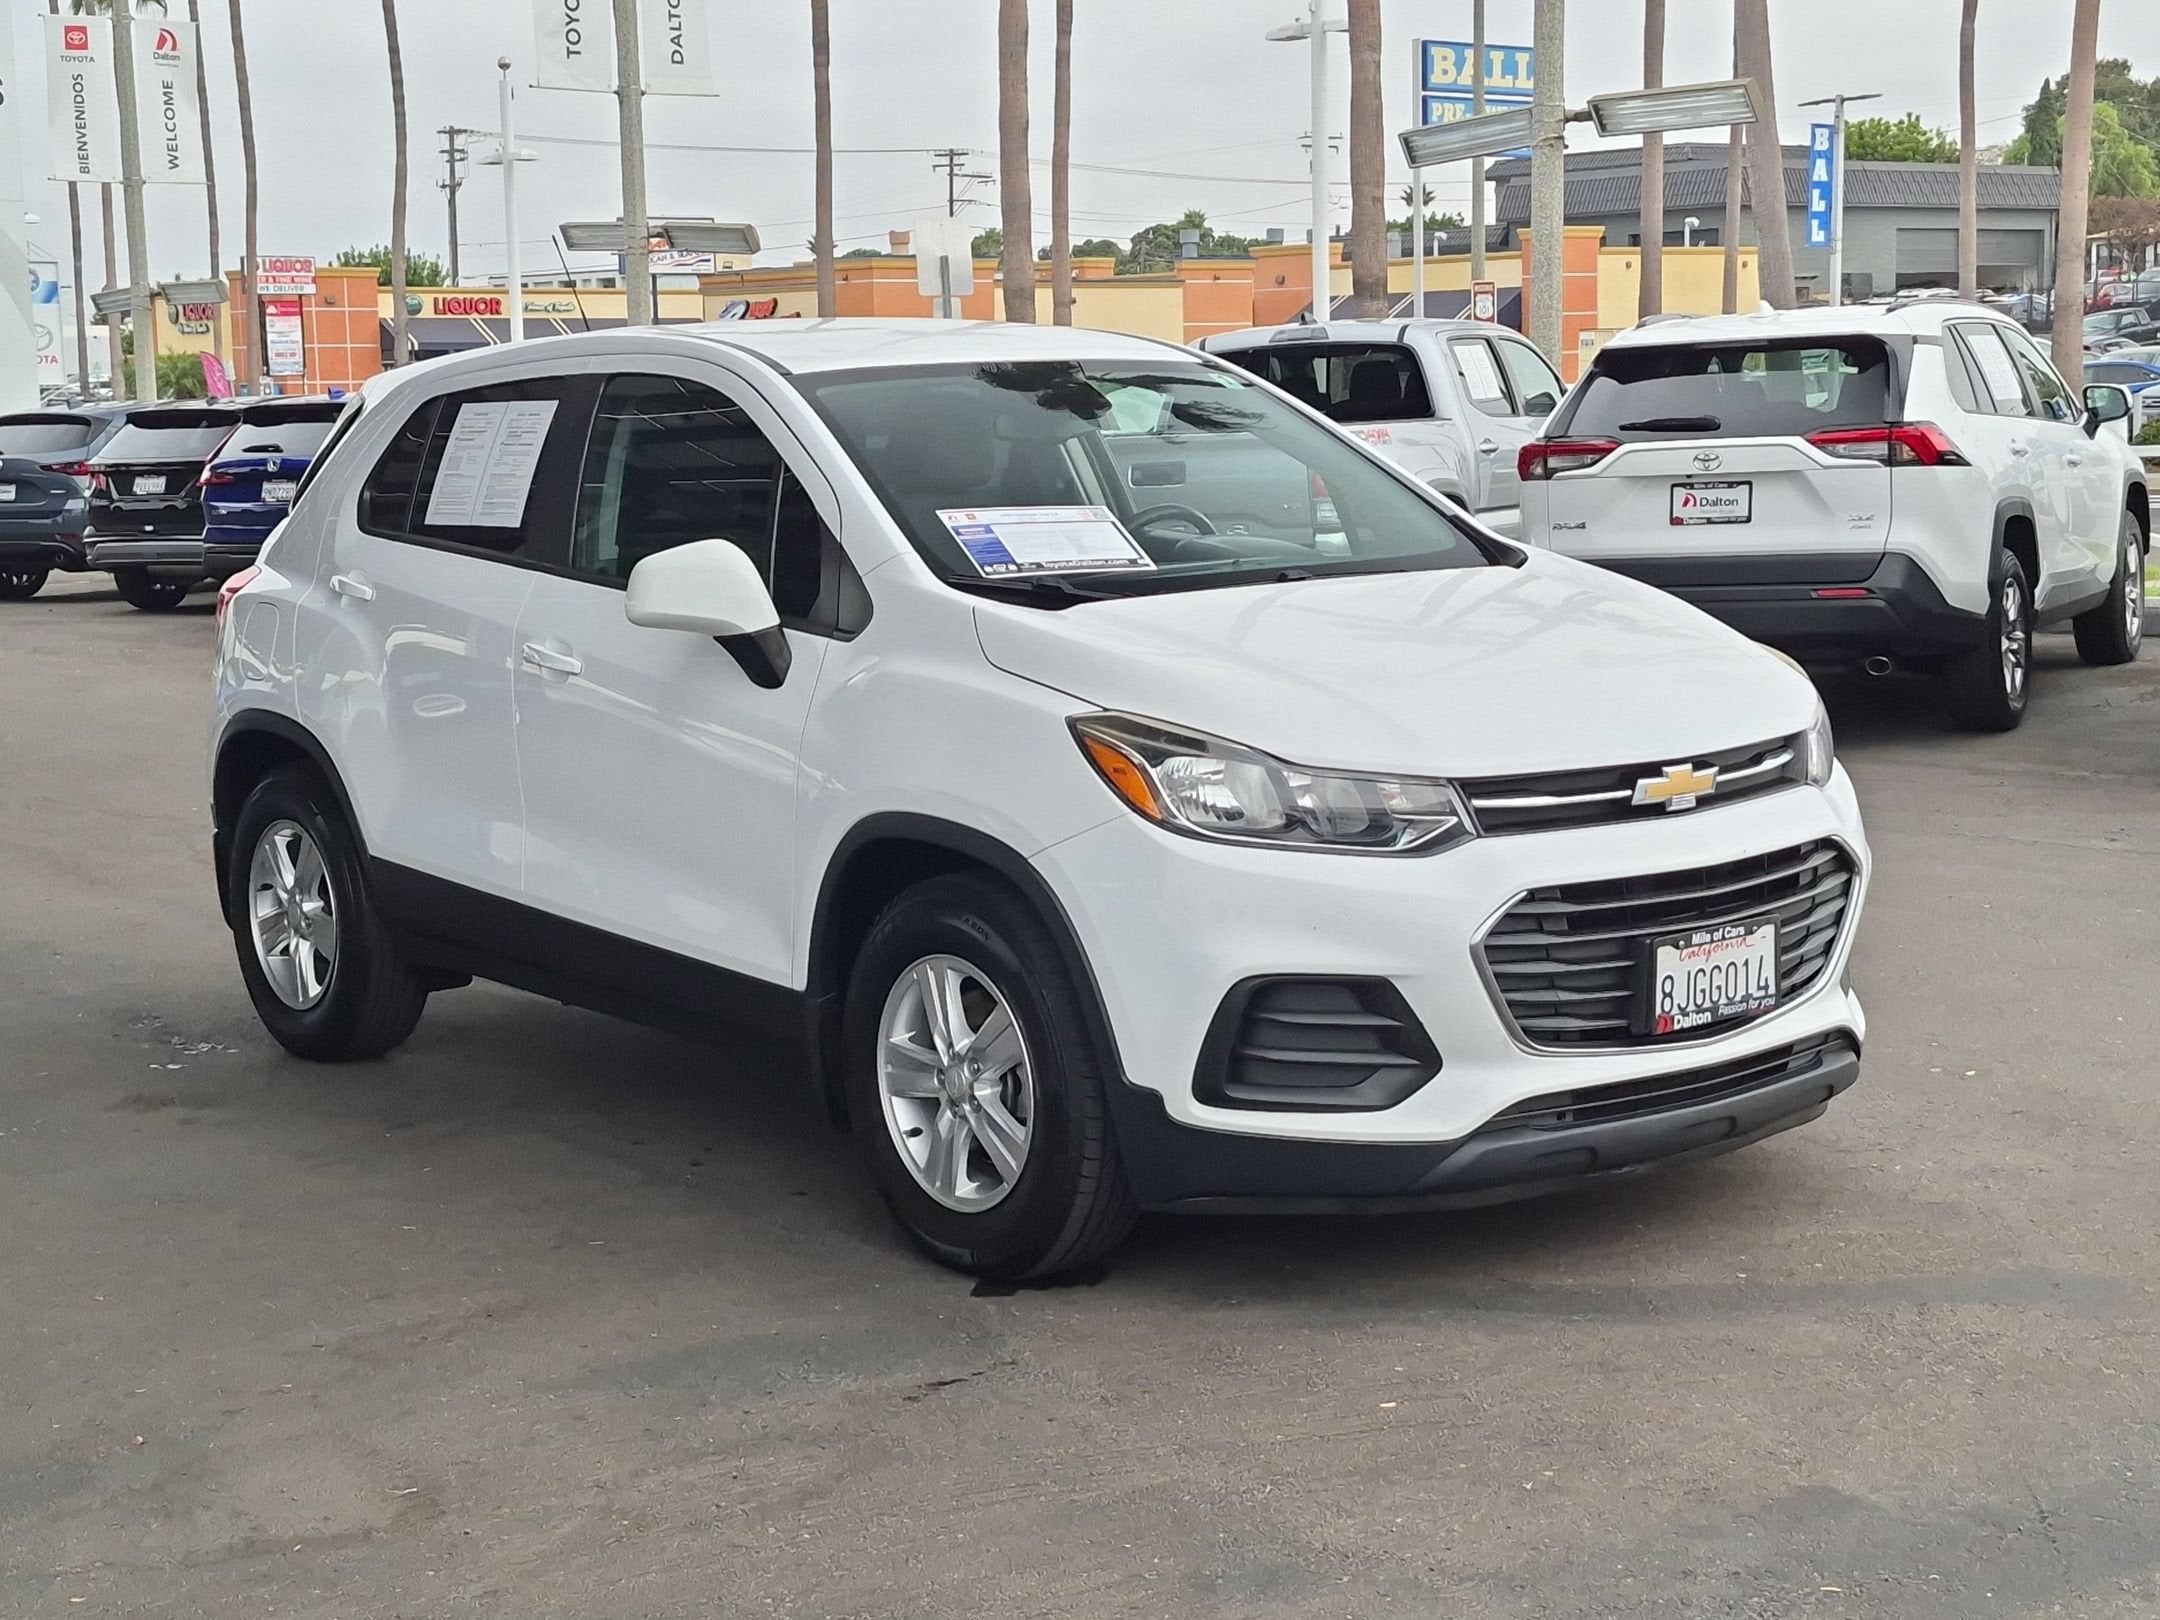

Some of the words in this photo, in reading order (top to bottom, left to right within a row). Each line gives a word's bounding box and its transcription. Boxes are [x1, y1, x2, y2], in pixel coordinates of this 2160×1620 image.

[60, 55, 95, 63] TOYOTA
[153, 51, 180, 61] Dalton
[72, 73, 91, 175] BIENVENIDOS
[162, 80, 180, 170] WELCOME
[1811, 127, 1830, 242] BALL
[262, 258, 313, 273] LIQUOR
[433, 296, 503, 315] LIQUOR
[1699, 496, 1739, 507] Dalton
[1692, 931, 1711, 945] Mile
[1713, 928, 1723, 940] of
[1725, 926, 1745, 938] Cars
[1679, 935, 1755, 963] California
[1661, 954, 1770, 1014] 8JGG014
[1674, 1011, 1711, 1029] Dalton
[1718, 1002, 1747, 1016] Passion
[1748, 998, 1759, 1010] for
[1760, 997, 1776, 1010] you
